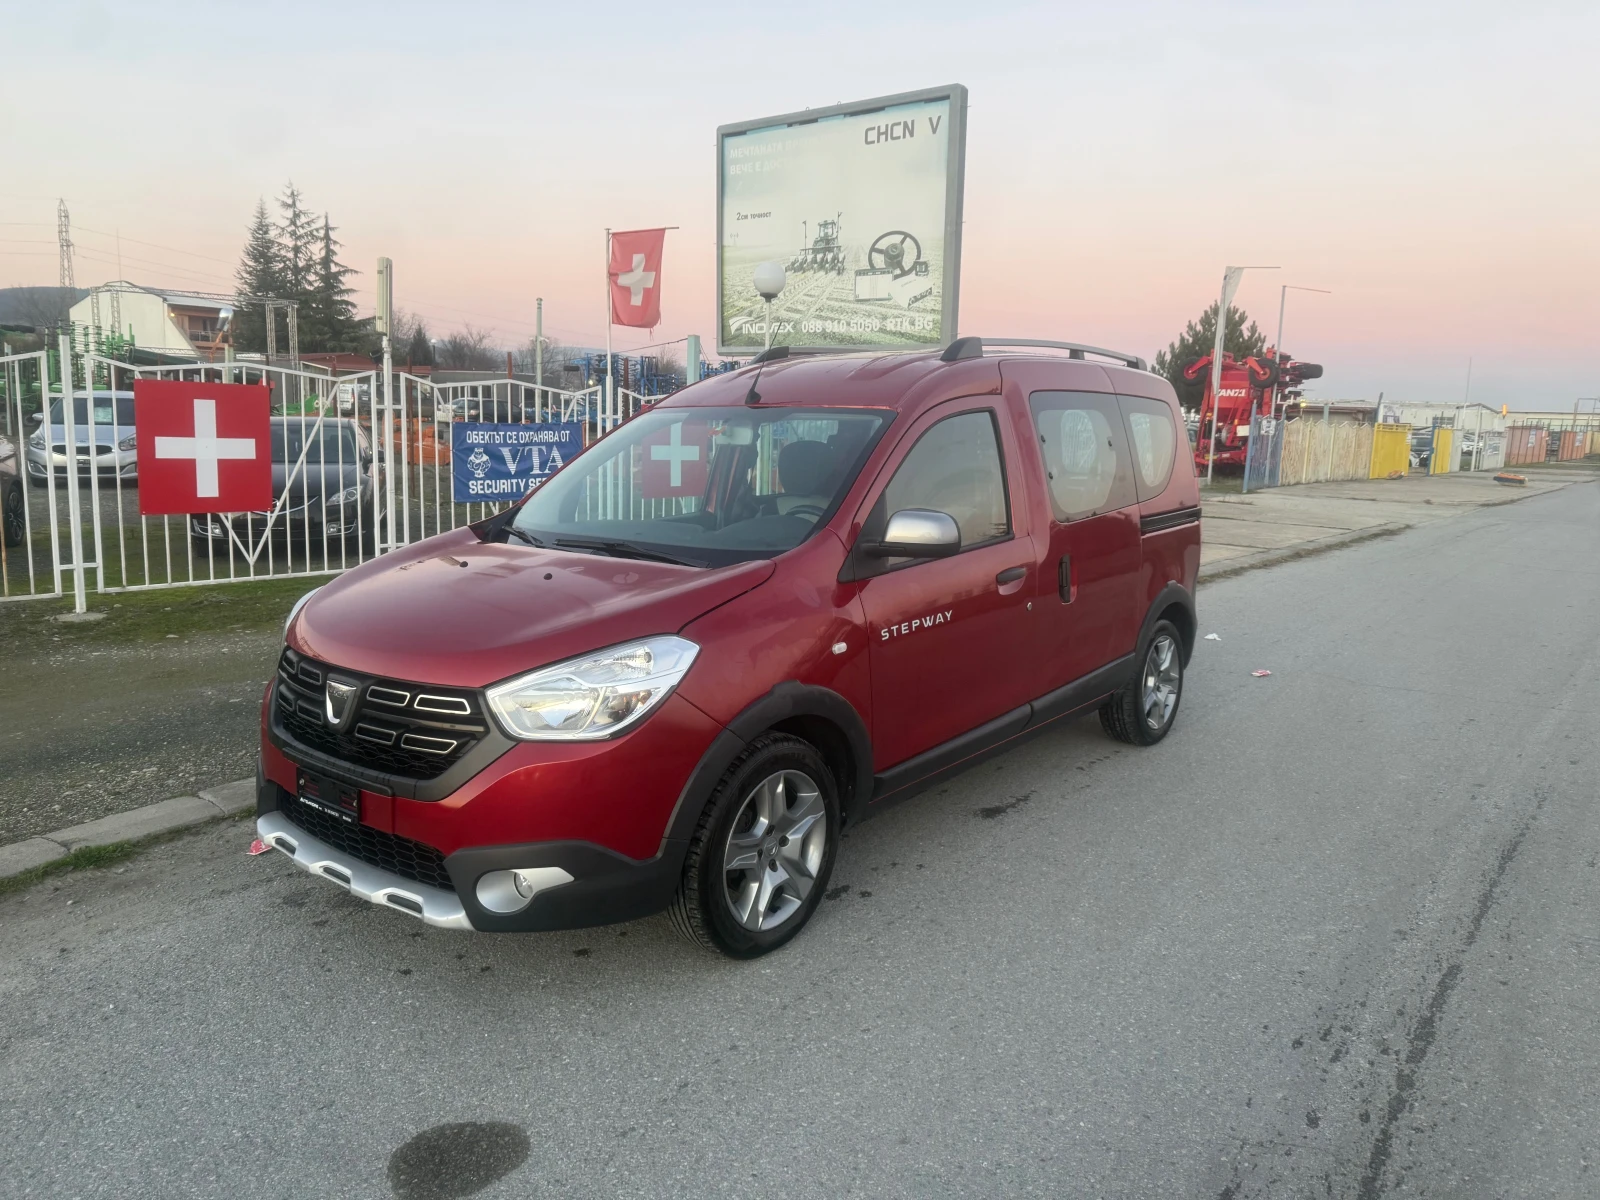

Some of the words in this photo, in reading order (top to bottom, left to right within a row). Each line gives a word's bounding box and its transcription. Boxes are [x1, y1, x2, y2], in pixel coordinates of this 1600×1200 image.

[801, 319, 823, 333] 088
[825, 319, 847, 333] 910
[850, 318, 880, 332] 5050
[466, 431, 504, 444] ОБЕКТЪТ
[506, 431, 518, 444] СЕ
[519, 430, 560, 444] ОХРАНЯВА
[560, 430, 570, 442] ОТ
[498, 444, 564, 475] VTA
[468, 478, 526, 494] SECURITY
[880, 609, 953, 641] STEPWAY
